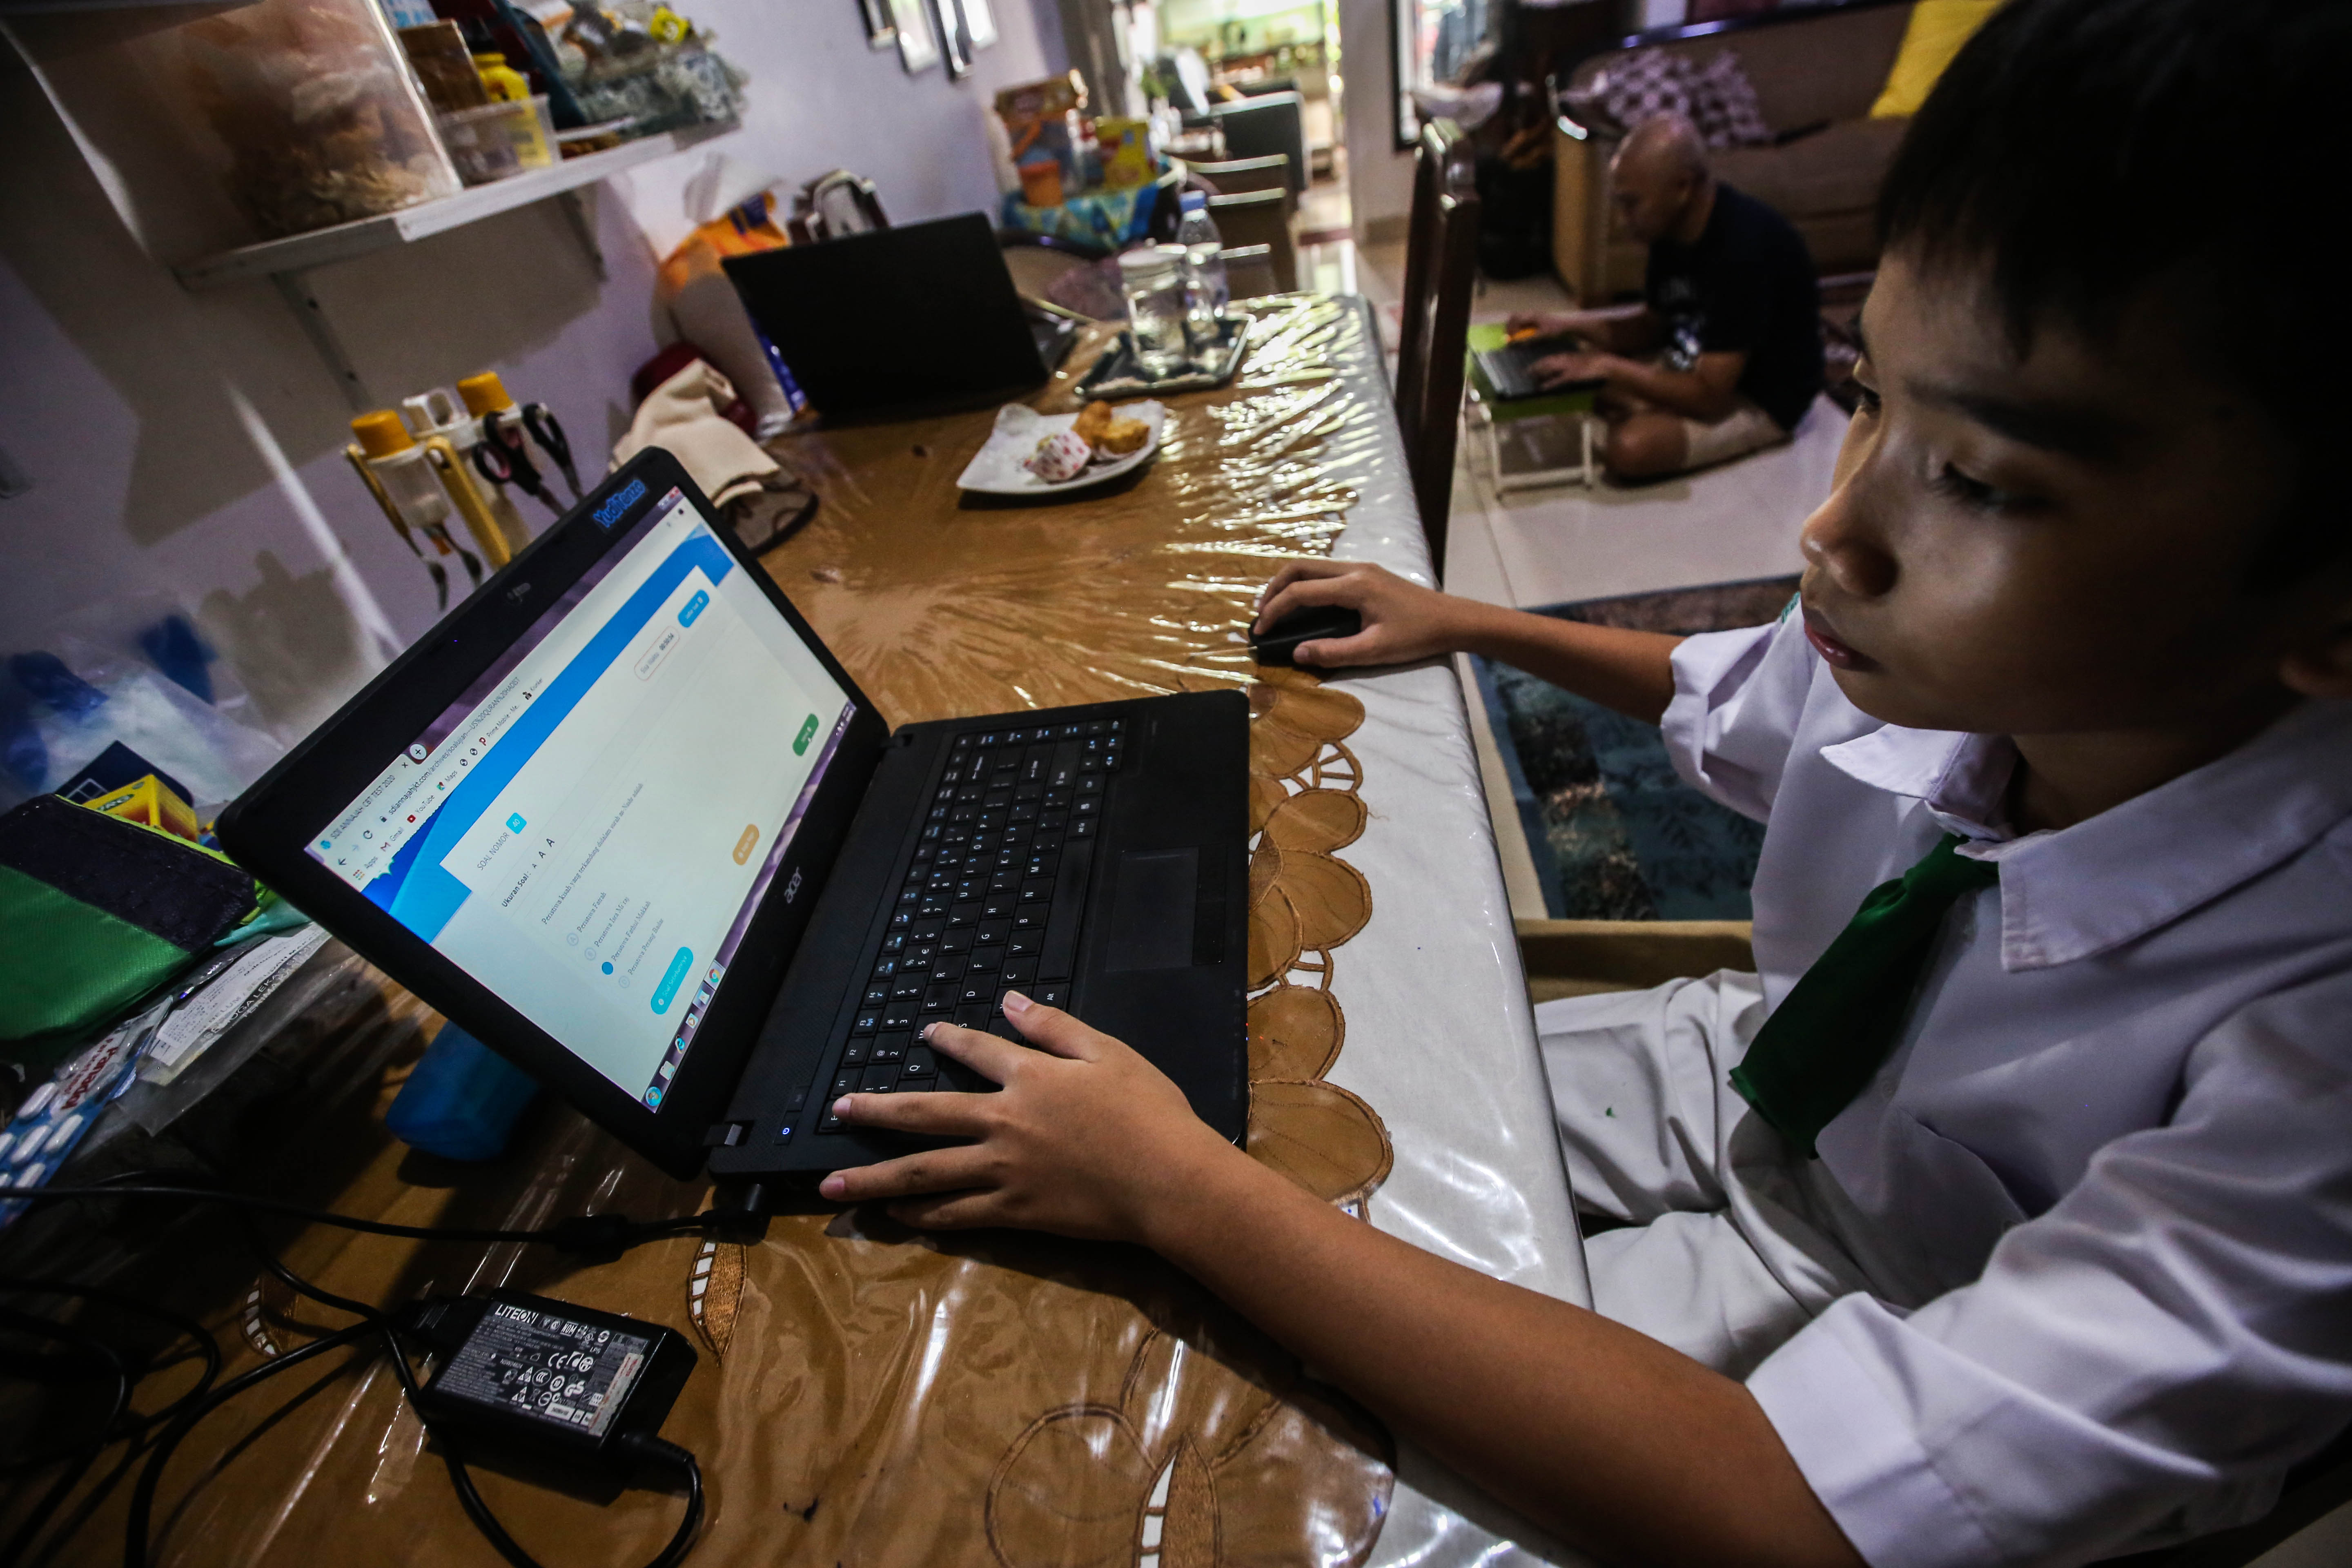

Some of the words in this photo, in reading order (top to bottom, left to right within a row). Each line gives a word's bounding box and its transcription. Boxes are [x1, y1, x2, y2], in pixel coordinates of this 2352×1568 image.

[363, 796, 371, 807] CBT
[371, 785, 382, 795] TEST
[382, 775, 395, 788] 2020
[364, 856, 378, 869] Apps
[390, 827, 403, 841] Gmail
[415, 795, 434, 812] YouTube
[445, 771, 457, 781] Maps
[486, 726, 499, 737] Prime
[497, 714, 510, 726] Mobile
[477, 855, 492, 870] SOAL
[489, 832, 510, 855] NOMOR
[513, 819, 520, 827] 40
[501, 886, 520, 907] Ukuran
[517, 873, 528, 887] Soal
[546, 839, 555, 847] A
[541, 900, 562, 924] Peristiwa
[559, 886, 572, 900] kisah
[570, 873, 581, 886] yang
[579, 846, 599, 873] terkandung
[784, 866, 802, 903] acer
[577, 909, 595, 933] Peristiwa
[594, 923, 612, 947] Peristiwa
[611, 938, 628, 962] Peristiwa
[628, 951, 644, 975] Peristiwa
[495, 1304, 539, 1324] LITEON
[561, 1323, 577, 1336] NOM
[548, 1353, 568, 1369] CE
[564, 1379, 585, 1398] GS
